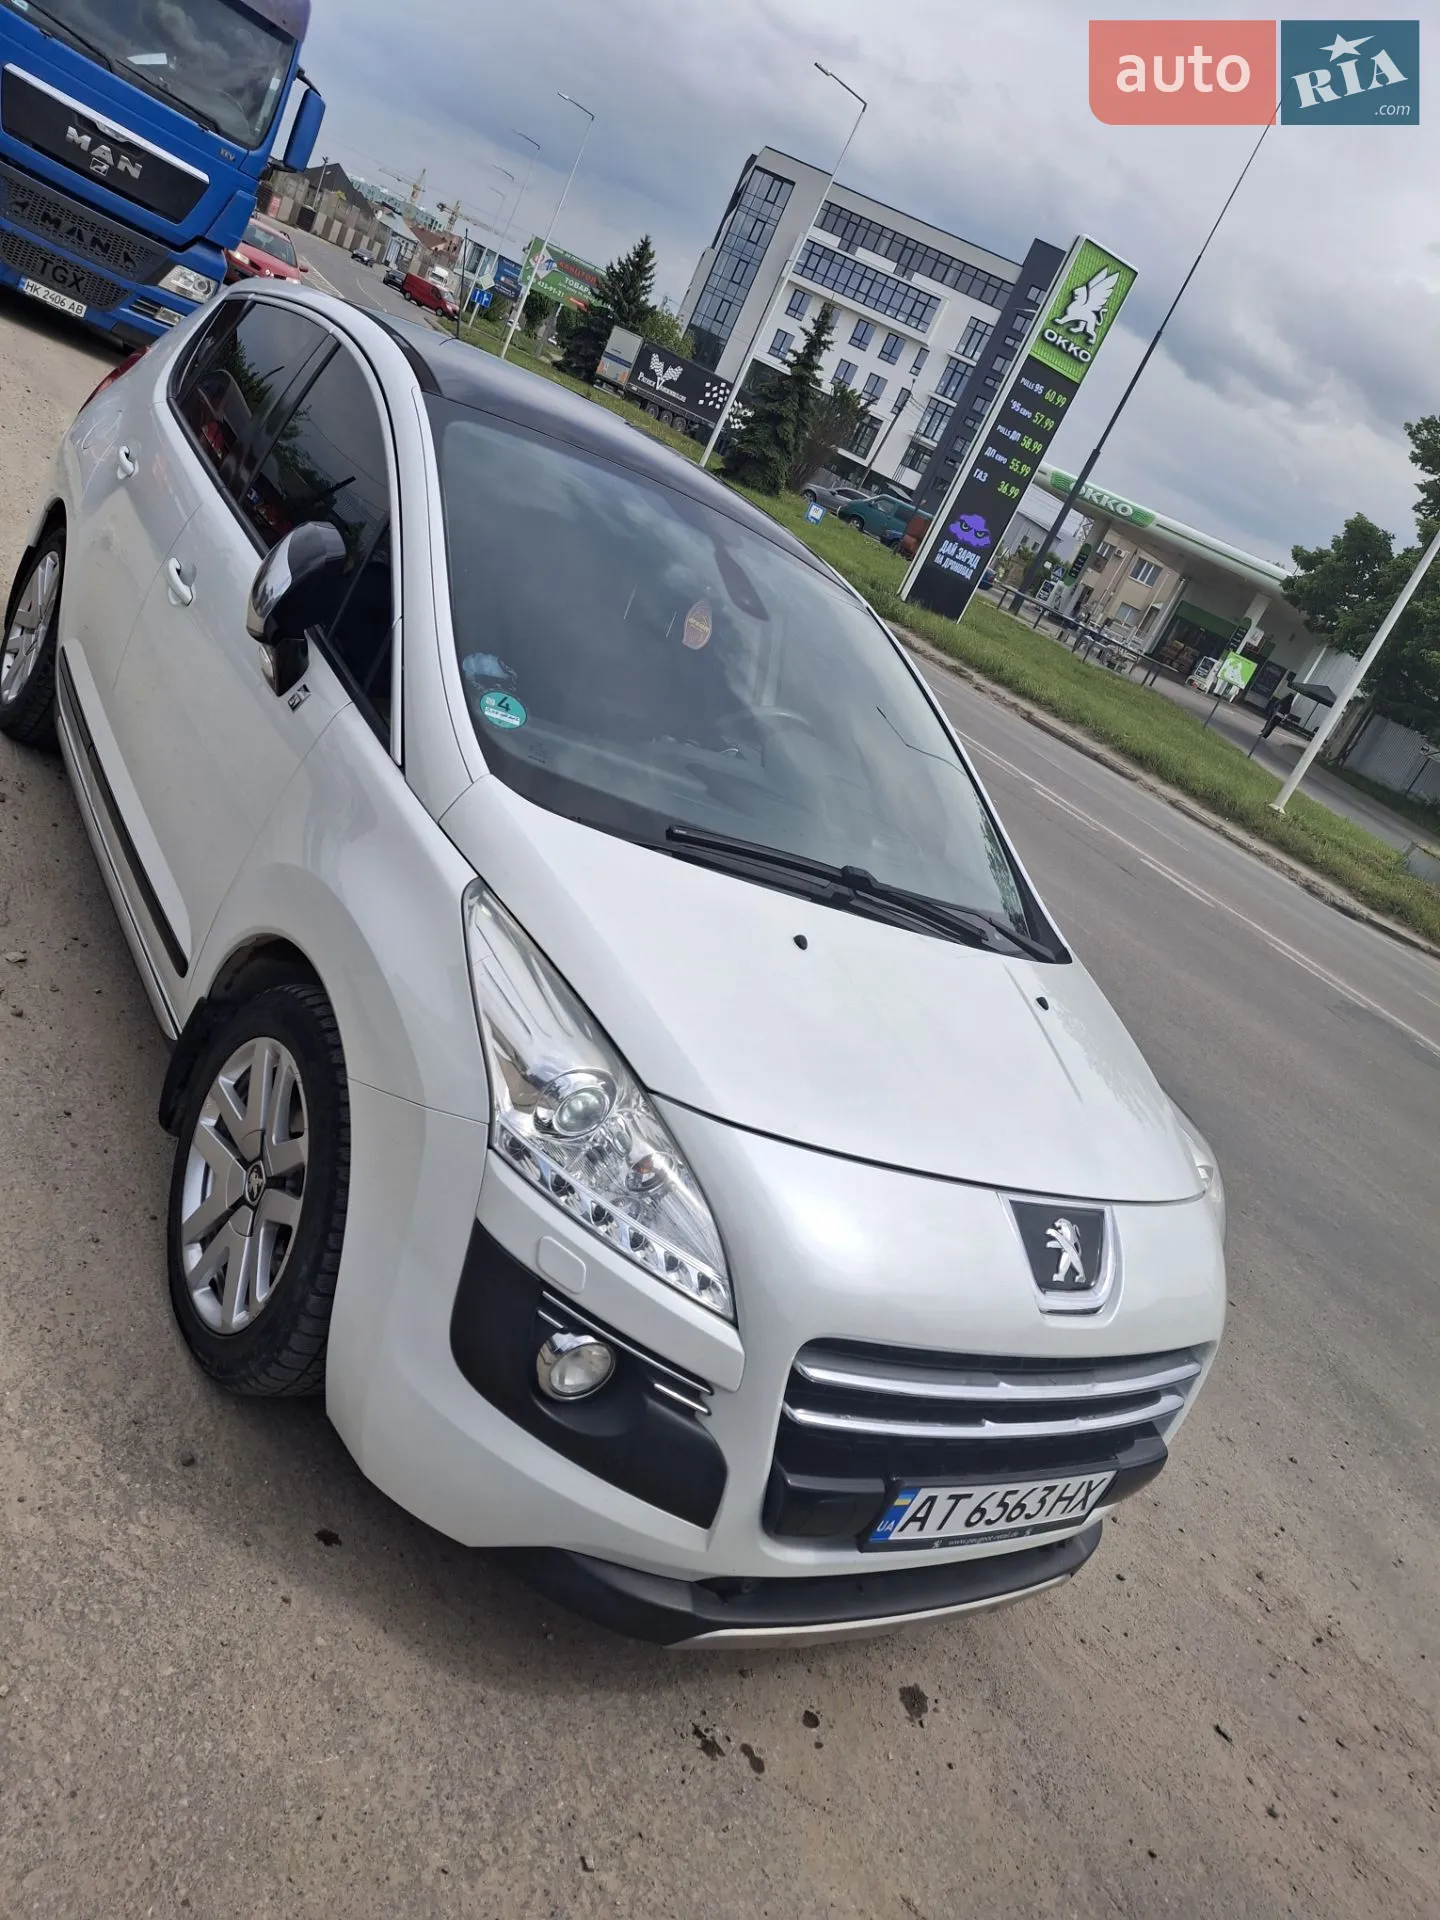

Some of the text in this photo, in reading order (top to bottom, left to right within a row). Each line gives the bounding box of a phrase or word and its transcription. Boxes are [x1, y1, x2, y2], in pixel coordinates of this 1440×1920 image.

[65, 125, 143, 180] MAN
[41, 210, 112, 254] MAN
[39, 256, 85, 292] TGX
[42, 288, 66, 307] 2406
[68, 301, 84, 315] AB
[1043, 328, 1092, 363] OKKO
[1044, 388, 1067, 408] 60.99
[1032, 411, 1055, 431] 57.99
[1020, 435, 1043, 455] 58.99
[1008, 458, 1031, 477] 55.99
[973, 467, 1020, 499] ГАЗ 36.99
[934, 553, 945, 565] НА
[938, 539, 981, 570] ДАЙ ЗАРЯД
[497, 696, 510, 712] 4
[876, 1519, 895, 1533] UA
